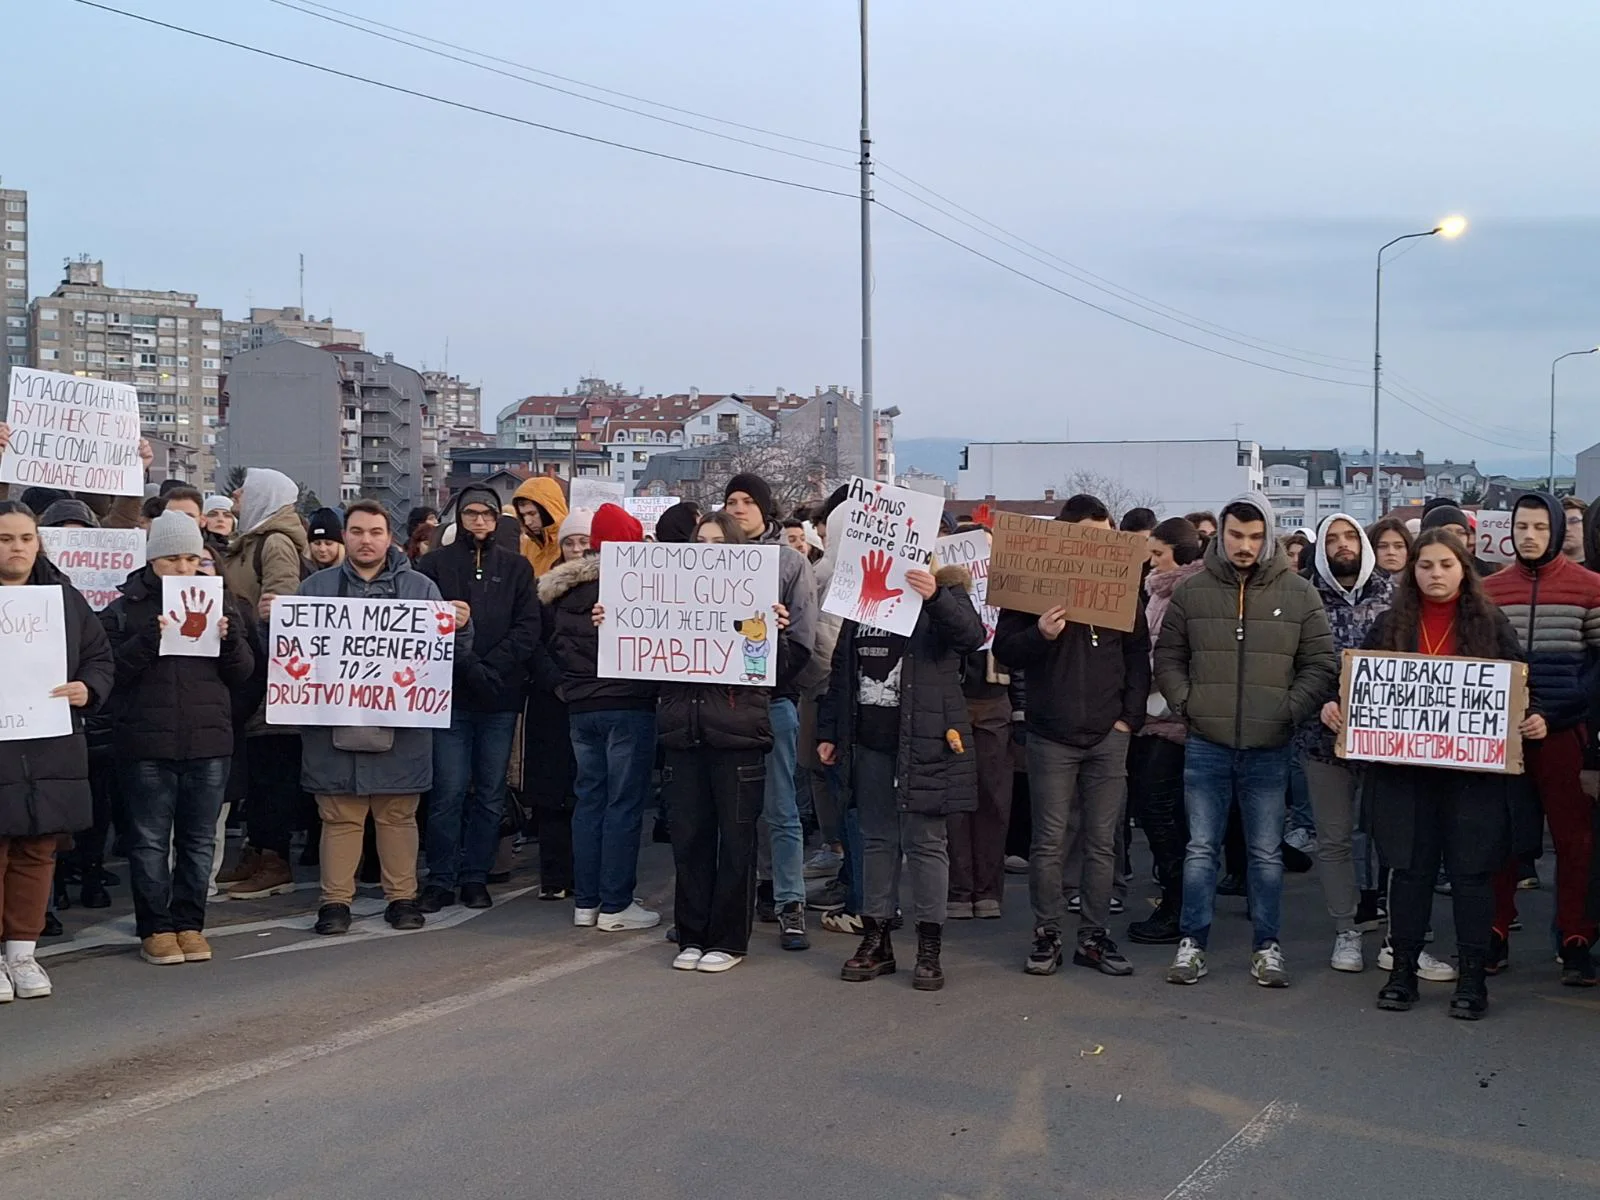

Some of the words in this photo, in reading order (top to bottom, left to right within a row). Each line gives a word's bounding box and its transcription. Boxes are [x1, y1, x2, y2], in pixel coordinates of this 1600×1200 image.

[14, 372, 99, 407] МЛАДОСТИ
[60, 407, 90, 435] НЕК
[97, 411, 111, 437] ТЕ
[31, 431, 54, 459] НЕ
[55, 435, 98, 463] СЛУША
[17, 459, 83, 487] СЛУШАЋЕ
[849, 478, 906, 516] Animus
[851, 508, 898, 538] tristis
[906, 518, 919, 545] in
[1482, 518, 1511, 529] sreć
[846, 528, 895, 551] corpore
[1480, 533, 1516, 556] 20
[59, 551, 134, 570] ПЛАЦЕБО
[702, 548, 762, 572] САМО
[996, 552, 1024, 569] ШТО
[621, 571, 686, 603] CHILL
[694, 575, 754, 606] GUYS
[0, 599, 49, 643] бије!
[281, 603, 352, 630] JETRA
[362, 603, 427, 633] MOŽE
[616, 607, 669, 630] КОЈИ
[677, 610, 728, 632] ЖЕЛЕ
[276, 635, 304, 657] DA
[310, 635, 331, 656] SE
[342, 636, 453, 661] REGENERIŠE
[618, 636, 734, 675] ПРАВДУ
[1354, 658, 1397, 682] АКО
[1400, 660, 1453, 685] ОВАКО
[1463, 663, 1495, 688] СЕ
[268, 677, 344, 706] DRUŠTVO
[348, 685, 396, 711] MORA
[404, 686, 450, 714] 100%
[1352, 682, 1416, 706] НАСТАВИ
[1418, 684, 1456, 708] ОВДЕ
[1461, 688, 1505, 710] НИКО
[1392, 708, 1450, 733] ОСТАТИ
